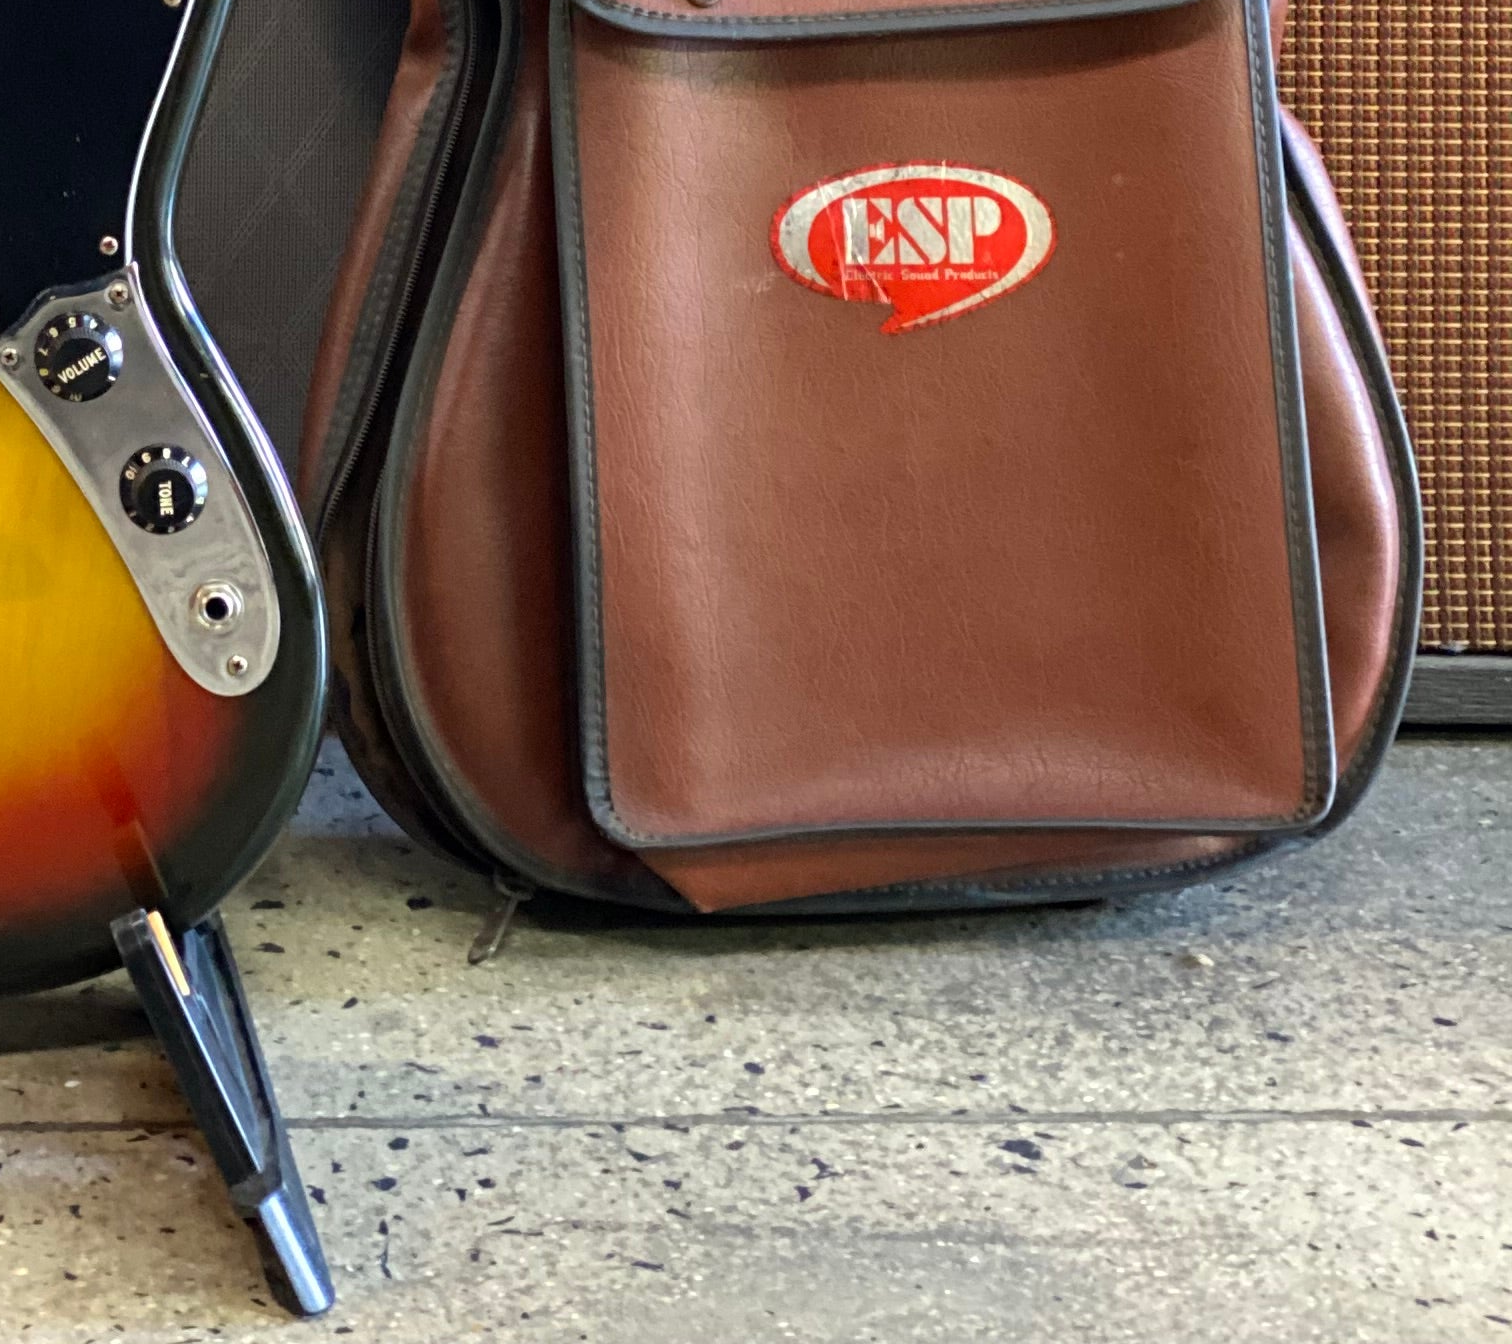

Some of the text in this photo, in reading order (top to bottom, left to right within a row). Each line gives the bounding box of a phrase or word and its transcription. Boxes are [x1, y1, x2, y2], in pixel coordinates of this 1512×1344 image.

[842, 196, 1002, 265] ESP
[901, 268, 939, 281] Sound
[944, 268, 1000, 281] Products
[57, 346, 107, 384] VOLUME
[158, 480, 175, 516] TONE
